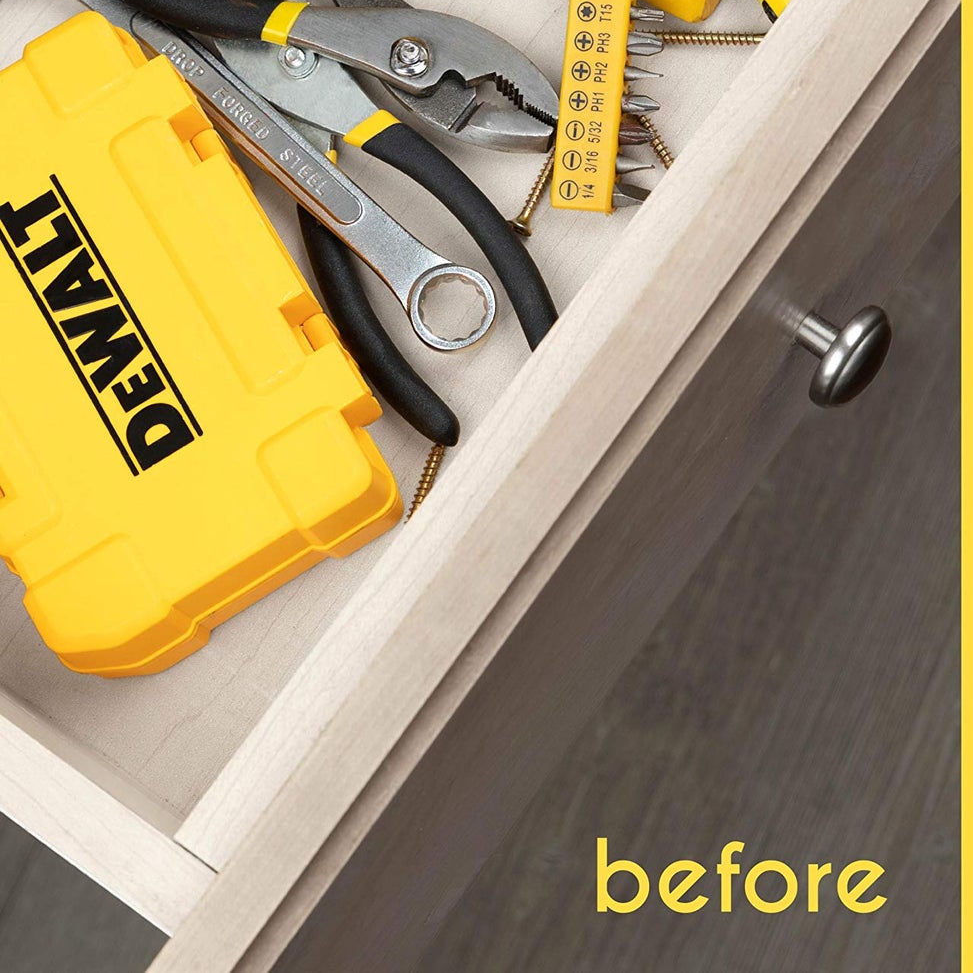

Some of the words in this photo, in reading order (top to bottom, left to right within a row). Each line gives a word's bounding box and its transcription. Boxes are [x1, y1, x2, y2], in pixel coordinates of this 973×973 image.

[600, 3, 613, 22] T15
[597, 32, 611, 54] PH3
[594, 61, 608, 83] PH2
[591, 91, 605, 112] PH1
[162, 41, 205, 77] DROP
[212, 87, 270, 141] FORGED
[280, 148, 328, 196] STEEL
[588, 121, 602, 144] 5/32
[585, 150, 599, 174] 3/16
[582, 183, 596, 200] 1/4
[0, 188, 195, 470] DEWALT
